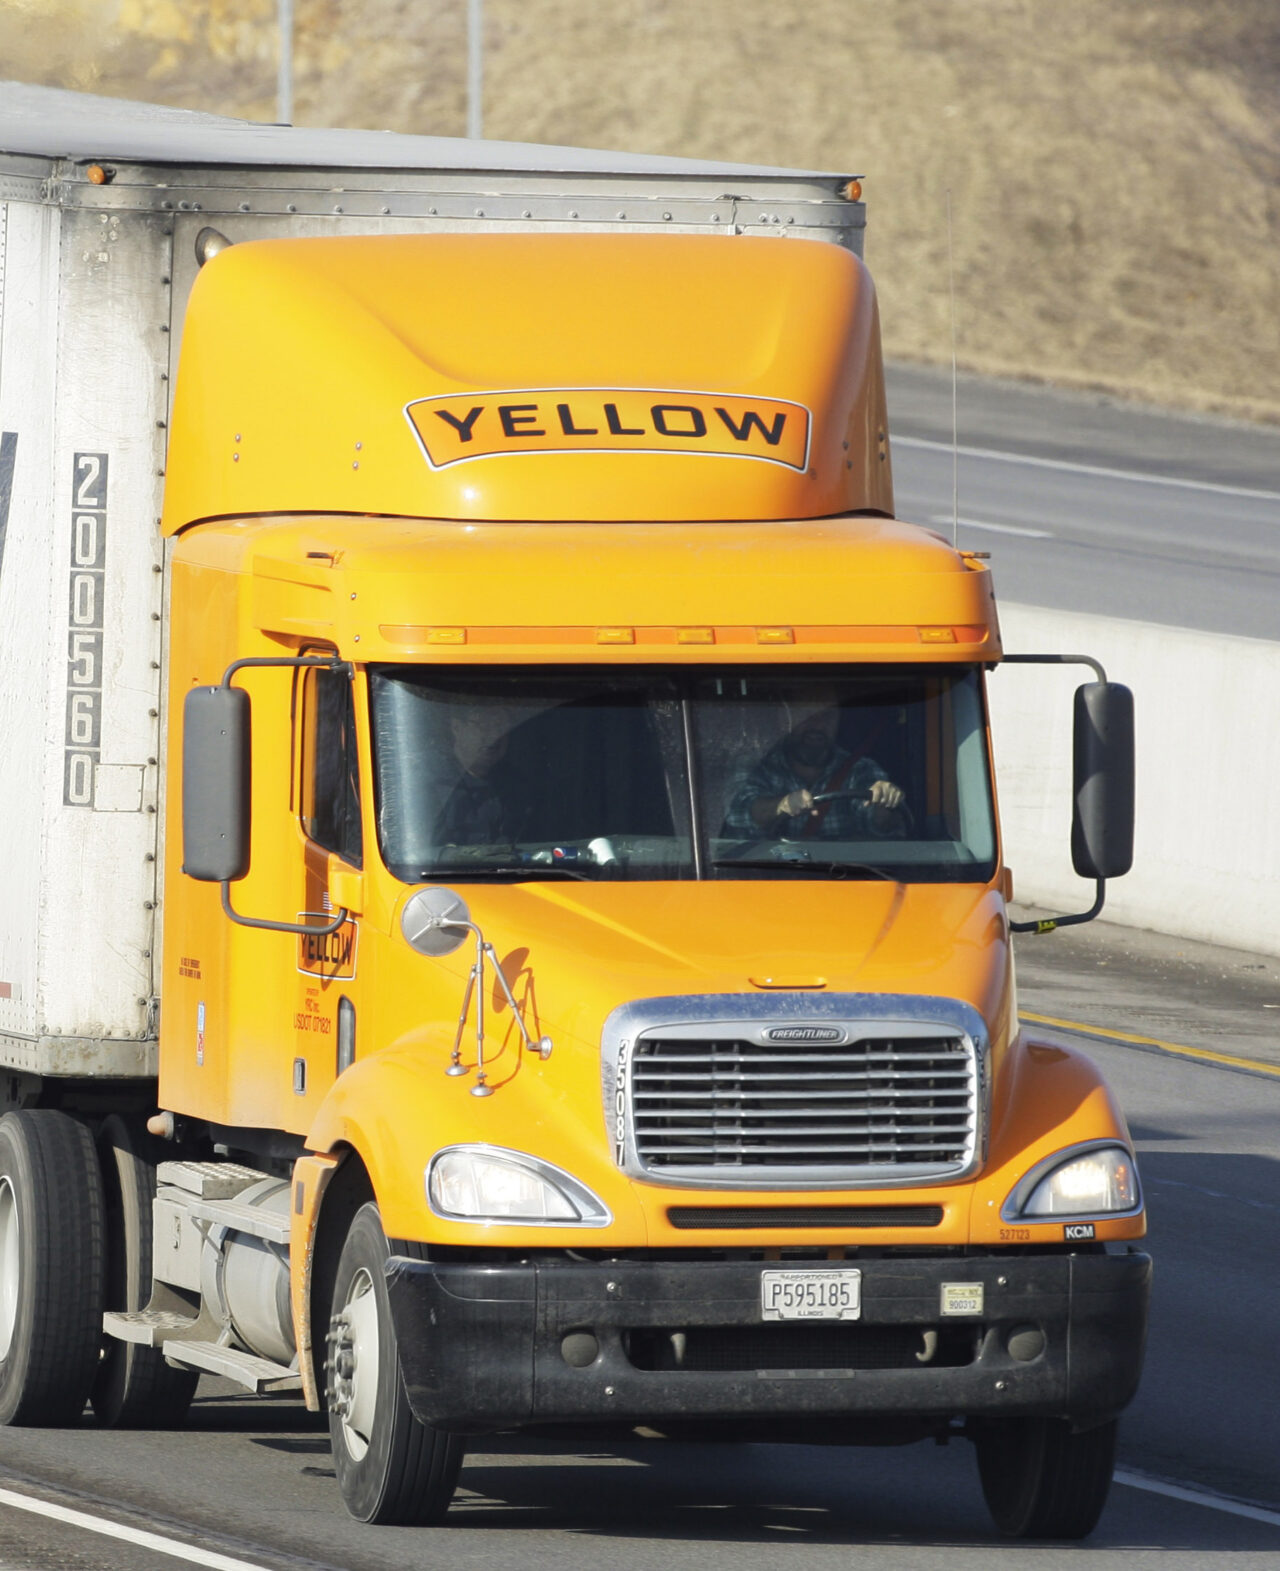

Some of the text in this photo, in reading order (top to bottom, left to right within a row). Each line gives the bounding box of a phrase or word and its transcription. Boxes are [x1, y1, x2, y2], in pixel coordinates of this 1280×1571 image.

[433, 402, 787, 445] YELLOW
[65, 453, 105, 806] 200560
[301, 929, 355, 966] YELLOW
[771, 1029, 838, 1039] FREIGHTLINER
[1065, 1226, 1094, 1239] KCM
[772, 1282, 850, 1307] P595185
